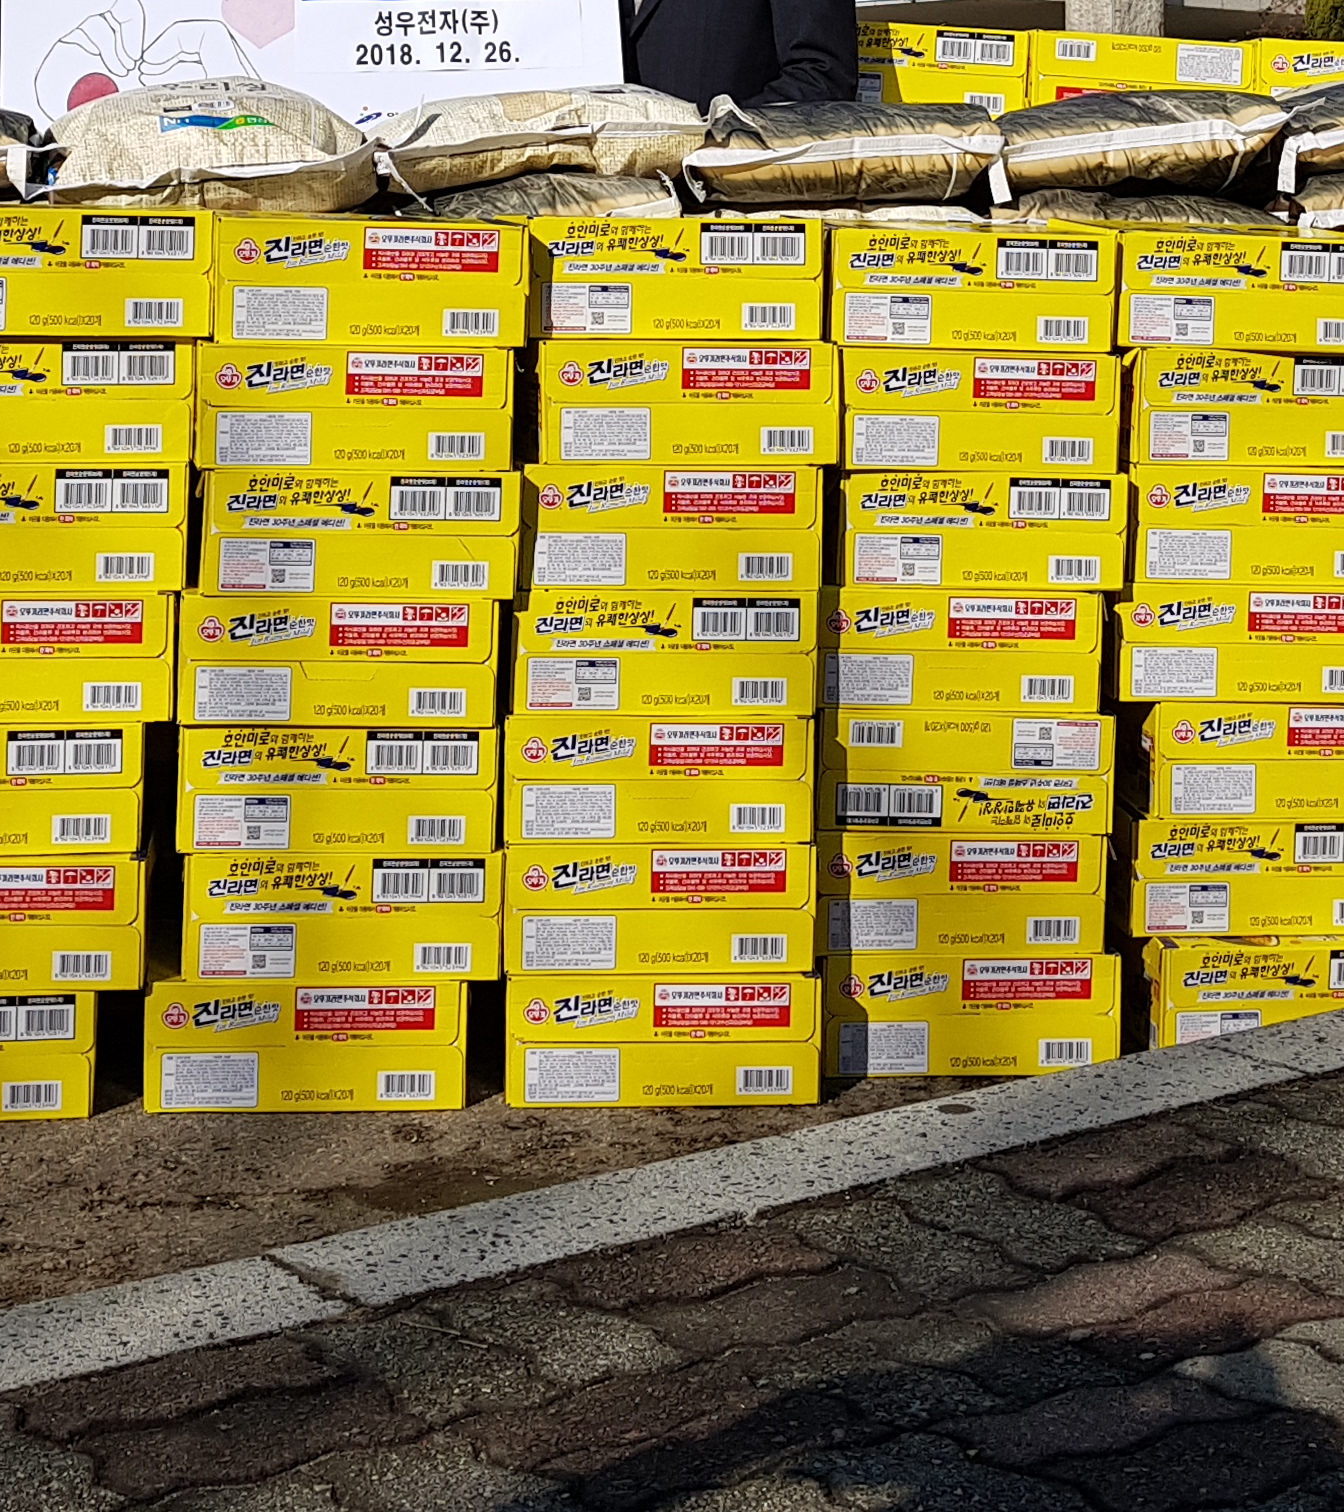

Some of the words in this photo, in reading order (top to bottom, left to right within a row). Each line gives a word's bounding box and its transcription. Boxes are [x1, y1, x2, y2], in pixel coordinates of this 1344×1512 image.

[374, 8, 498, 36] 성우전자(주)
[355, 43, 421, 66] 2018.
[435, 41, 470, 64] 12.
[484, 40, 520, 63] 26.
[264, 236, 324, 261] 진라면
[245, 361, 306, 387] 진라면
[587, 357, 644, 383] 진라면
[883, 366, 937, 391] 진라면
[567, 481, 625, 507] 진라면
[1173, 482, 1227, 506] 진라면
[228, 613, 289, 639] 진라면
[855, 606, 911, 631] 진라면
[1158, 601, 1212, 625] 진라면
[1198, 717, 1252, 741] 진라면
[551, 733, 610, 760] 진라면
[551, 860, 611, 888] 진라면
[856, 850, 912, 875] 진라면
[868, 970, 924, 995] 진라면
[192, 998, 254, 1026] 진라면
[553, 994, 614, 1022] 진라면
